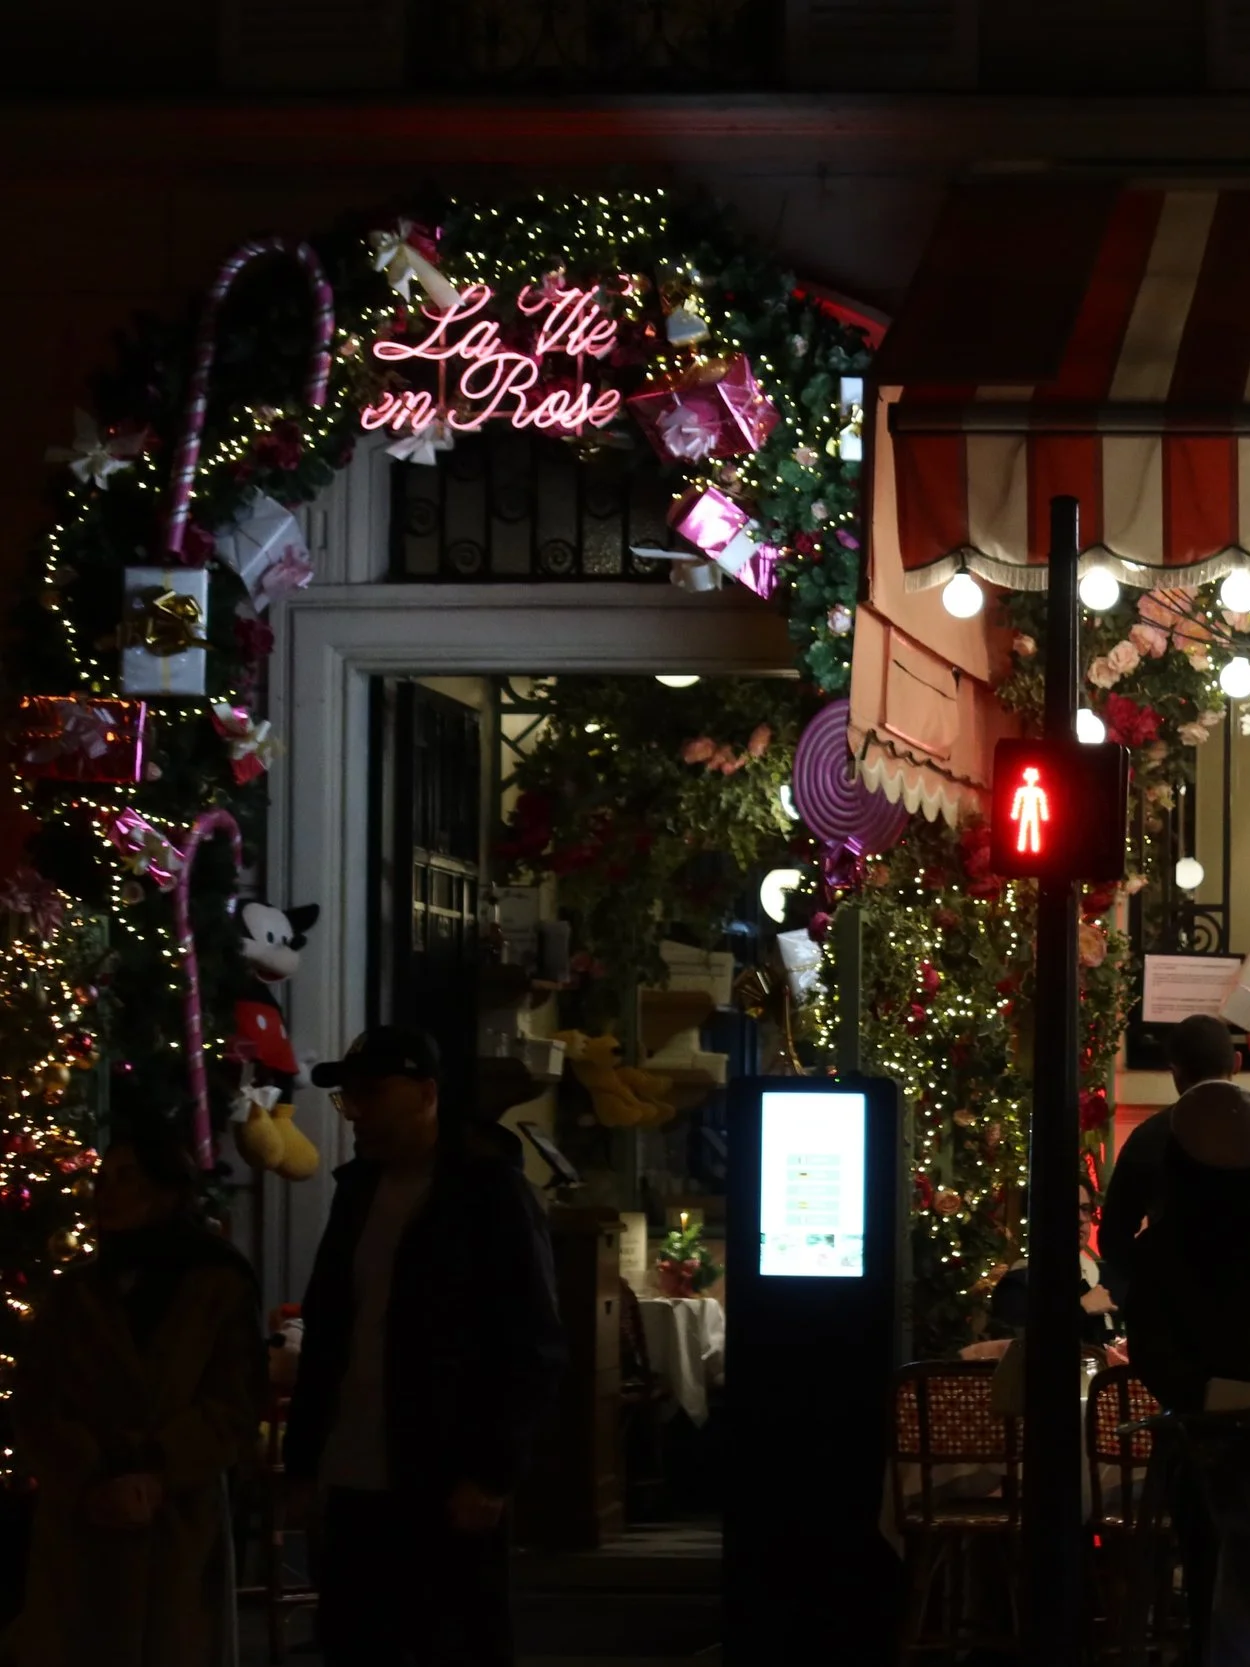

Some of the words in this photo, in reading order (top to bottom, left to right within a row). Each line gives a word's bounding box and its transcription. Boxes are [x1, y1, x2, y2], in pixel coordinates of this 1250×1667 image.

[373, 284, 501, 360] La
[517, 284, 618, 357] Vie
[361, 391, 437, 430] en
[448, 352, 620, 431] Rose
